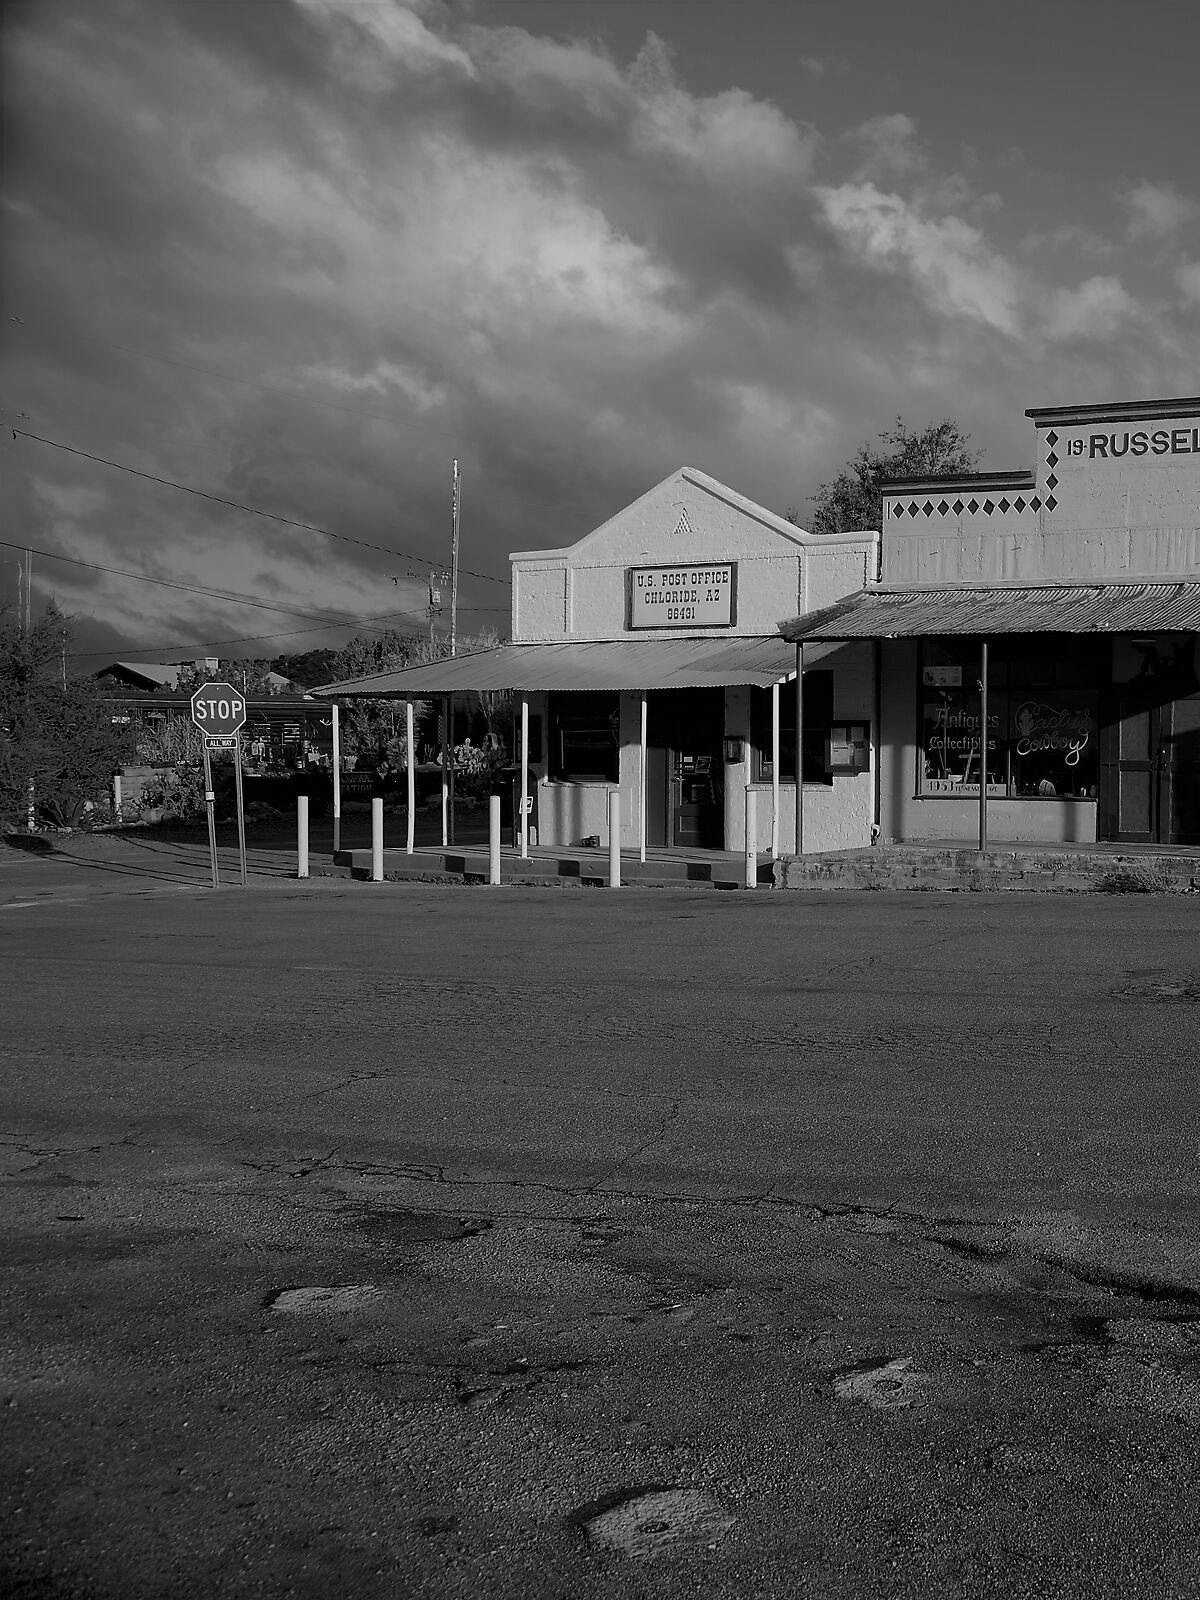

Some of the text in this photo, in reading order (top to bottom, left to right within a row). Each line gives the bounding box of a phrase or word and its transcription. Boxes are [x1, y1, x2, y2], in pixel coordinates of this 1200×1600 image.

[637, 571, 728, 587] U.S. POST OFFICE
[644, 589, 720, 604] CHLORIDE, AZ
[667, 607, 695, 620] 86431
[196, 700, 242, 719] STOP
[928, 736, 997, 751] Collectibls
[1016, 728, 1089, 766] Cowboy
